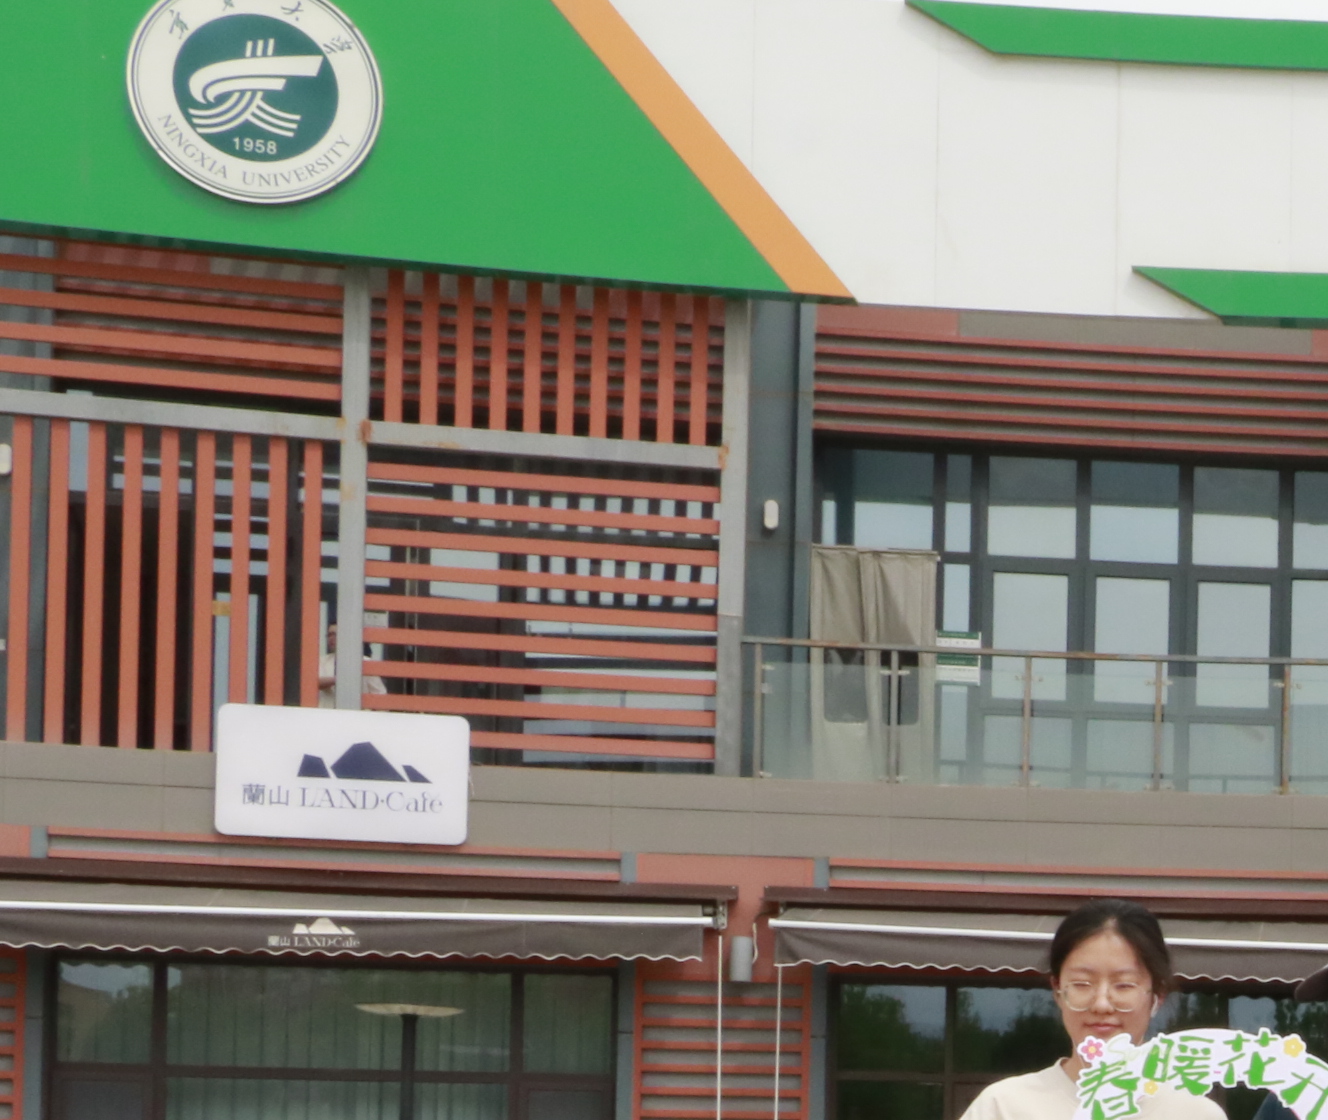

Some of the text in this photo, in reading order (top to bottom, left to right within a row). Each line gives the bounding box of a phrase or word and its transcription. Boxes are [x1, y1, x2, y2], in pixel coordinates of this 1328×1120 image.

[157, 114, 351, 187] NINGXIA UNIVERSITY
[232, 137, 278, 155] 1958
